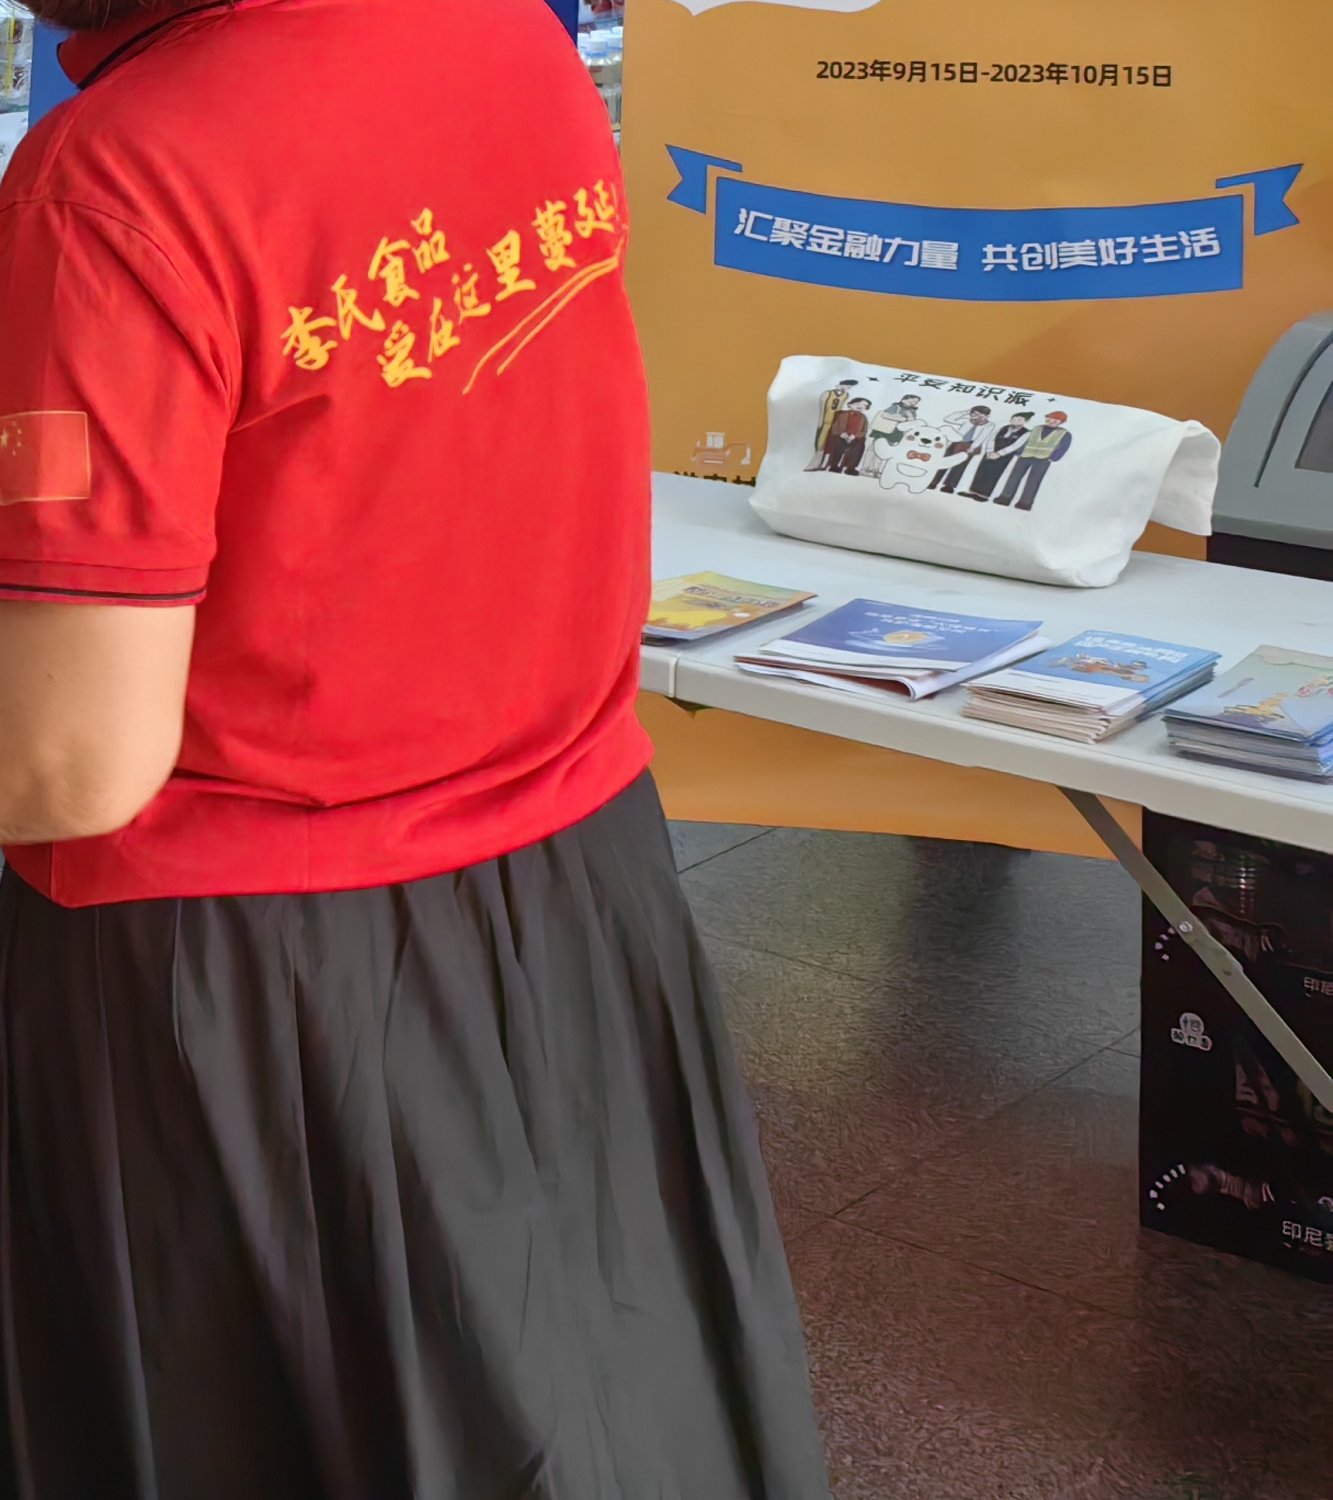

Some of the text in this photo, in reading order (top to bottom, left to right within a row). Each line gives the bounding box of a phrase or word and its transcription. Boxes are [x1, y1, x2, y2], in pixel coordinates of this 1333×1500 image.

[815, 59, 1173, 88] 2023年9月15日-2023年10月15日
[733, 207, 1222, 272] 汇聚金融力量 共创美好生活
